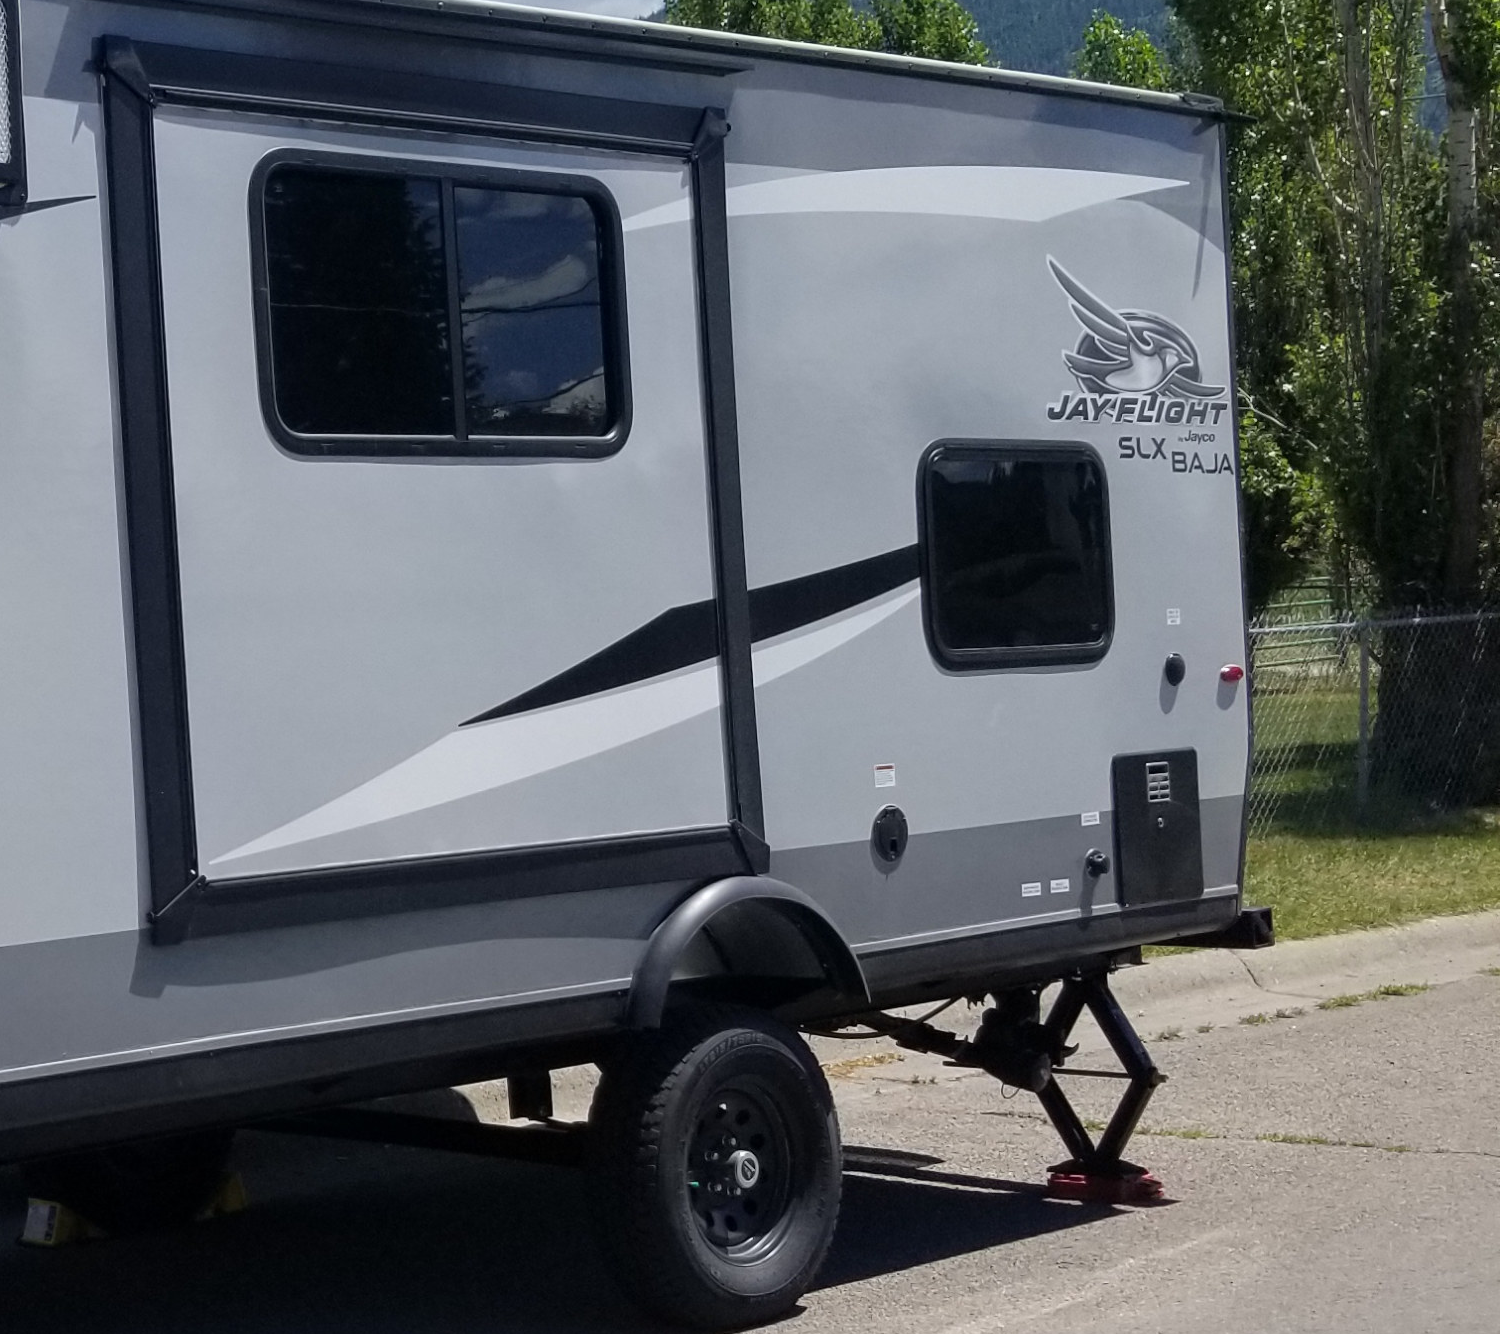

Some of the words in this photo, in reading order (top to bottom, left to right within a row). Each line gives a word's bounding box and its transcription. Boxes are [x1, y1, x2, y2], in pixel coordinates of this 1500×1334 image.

[1118, 436, 1167, 460] SLX
[1184, 429, 1216, 445] Jayco
[1171, 451, 1235, 475] BAJA
